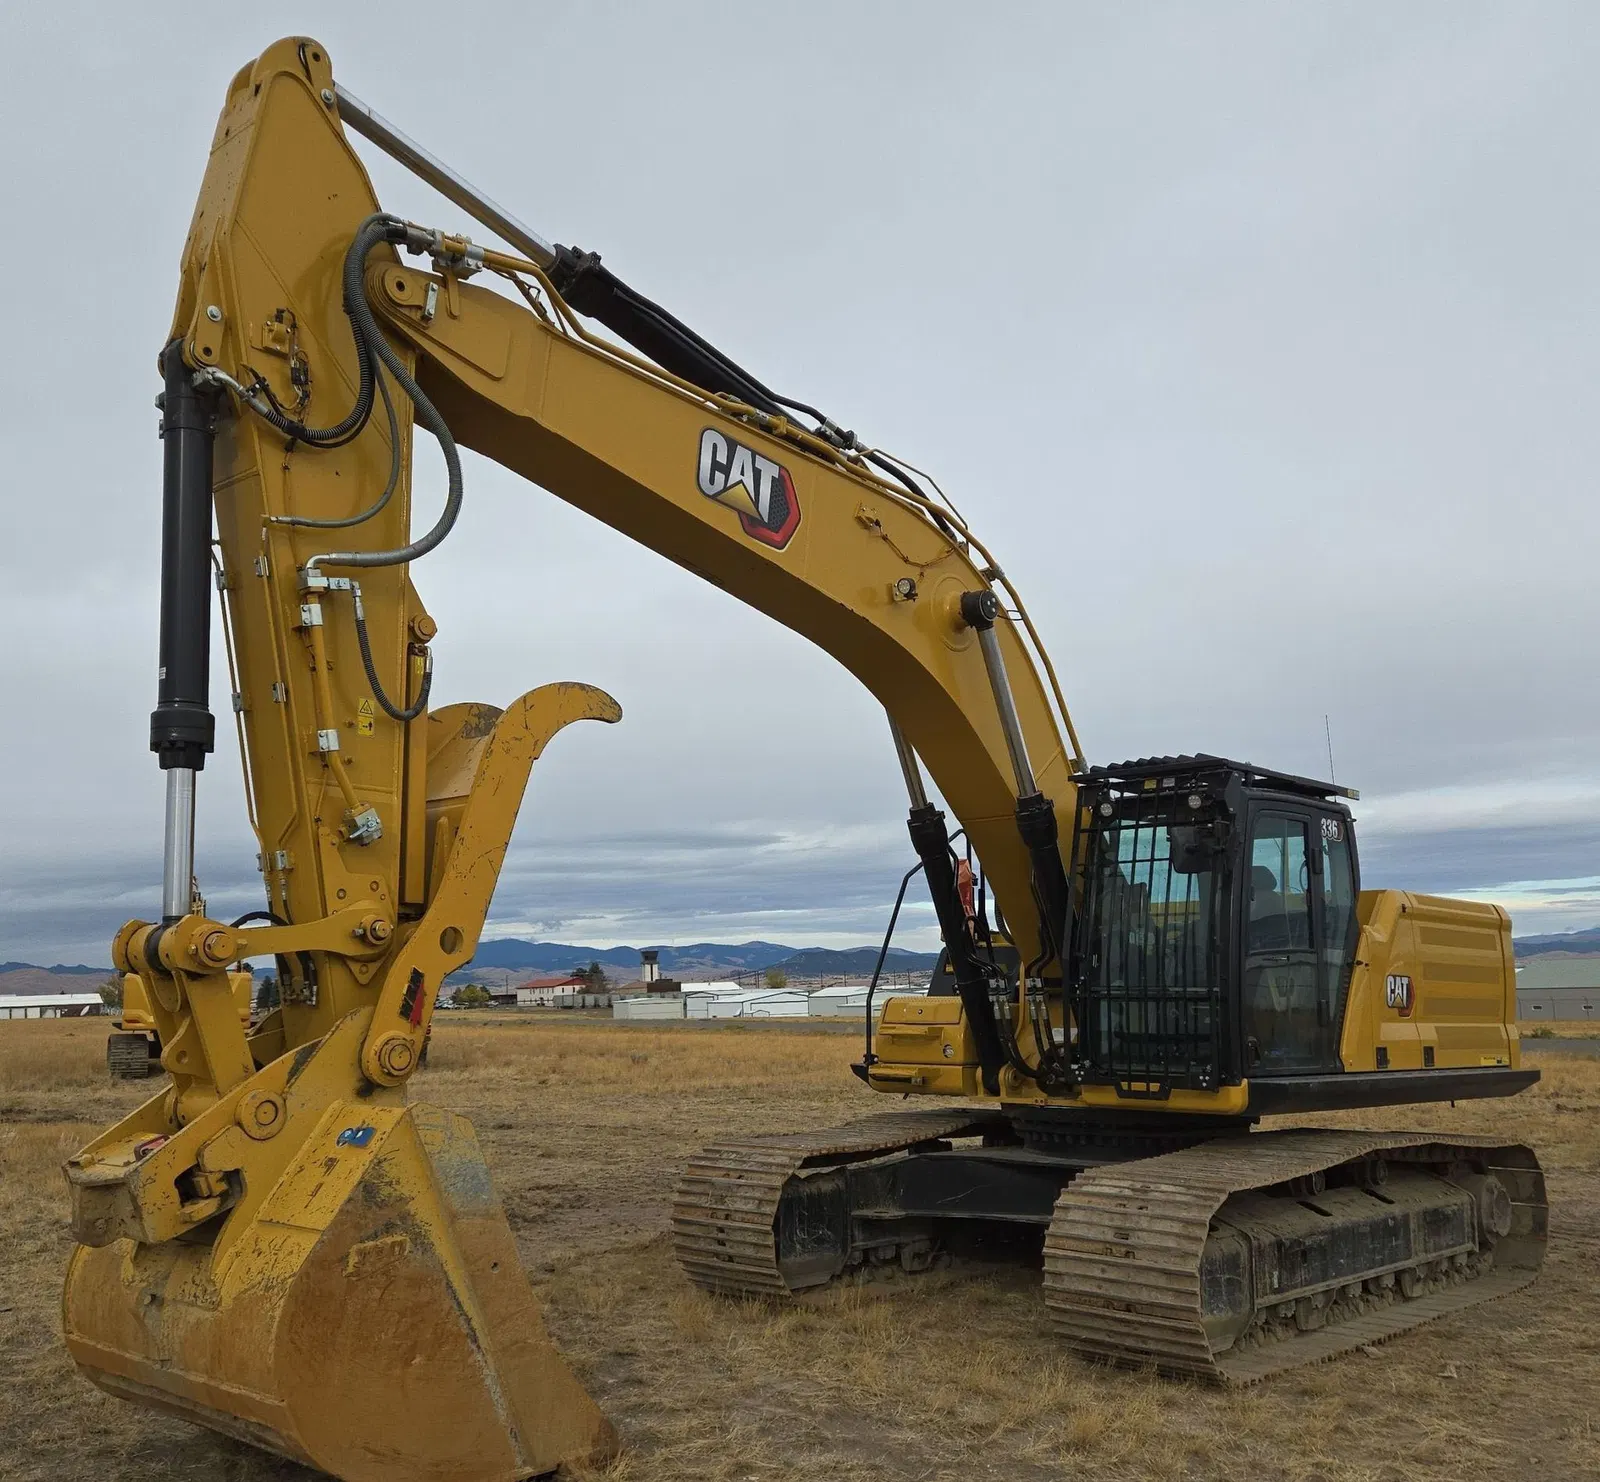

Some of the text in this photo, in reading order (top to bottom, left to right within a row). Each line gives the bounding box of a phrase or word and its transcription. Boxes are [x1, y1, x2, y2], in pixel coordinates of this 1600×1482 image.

[698, 428, 780, 523] CAT
[1320, 817, 1339, 839] 336
[1387, 975, 1409, 1008] CAT
